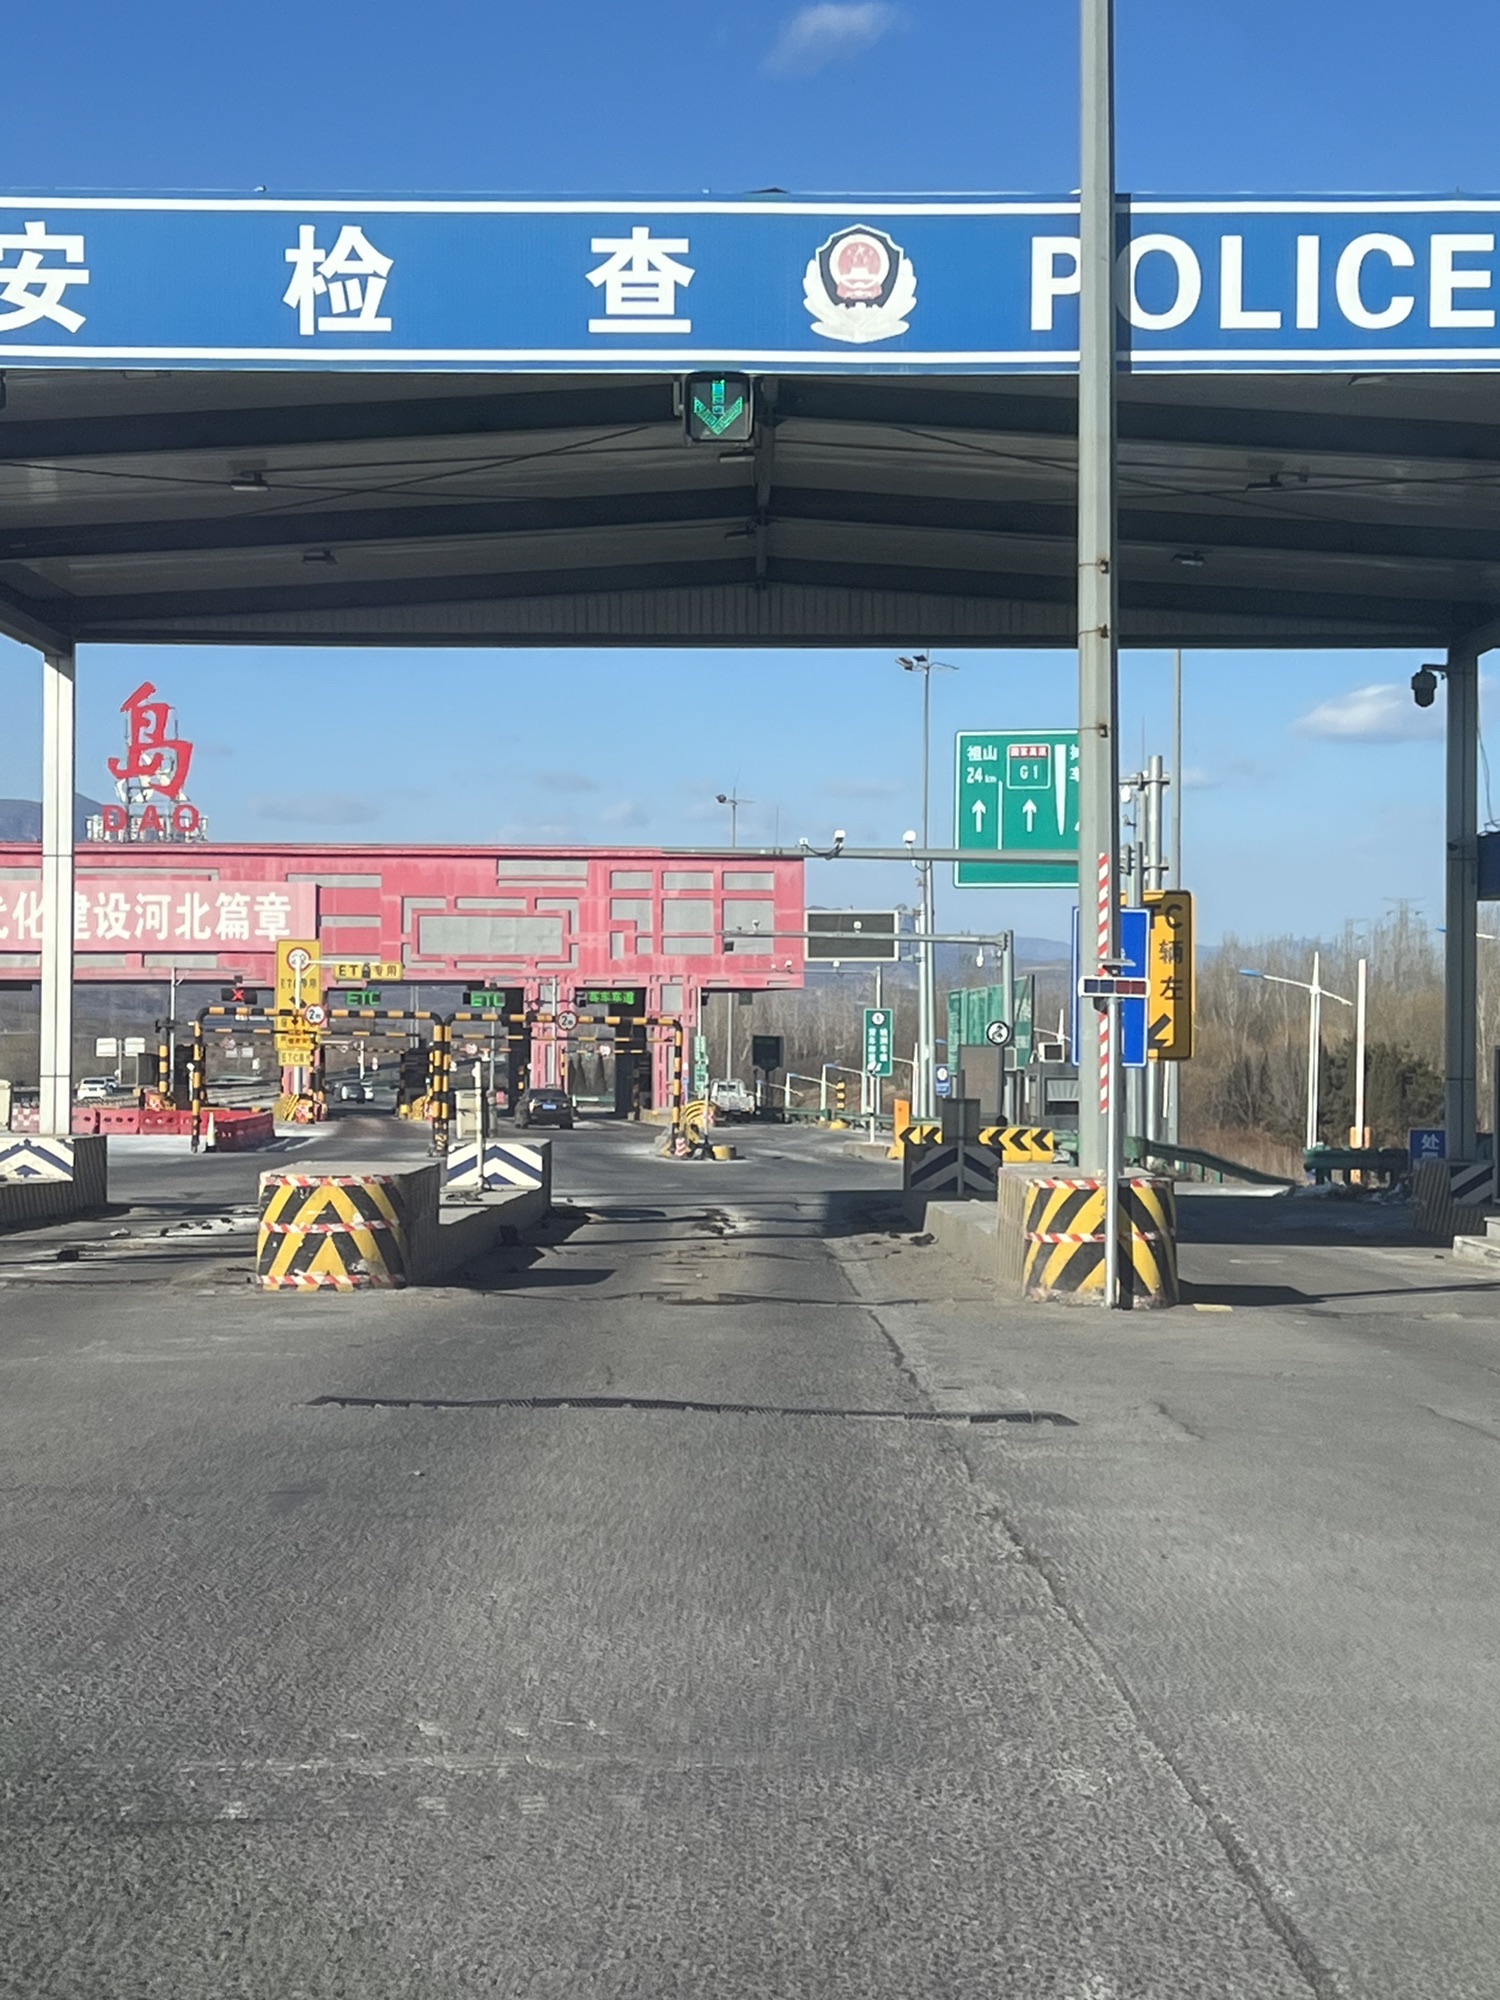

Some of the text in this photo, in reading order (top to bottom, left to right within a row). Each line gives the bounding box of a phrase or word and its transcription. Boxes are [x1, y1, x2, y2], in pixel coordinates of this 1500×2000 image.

[1031, 234, 1495, 331] POLICE
[107, 681, 194, 799] 岛
[966, 745, 997, 762] 祖山
[966, 767, 983, 784] 24
[103, 804, 200, 832] DAO
[0, 891, 292, 941] 化设河北篇章
[338, 964, 398, 977] ET专用
[346, 991, 381, 1006] ETC
[1159, 975, 1184, 1001] 左
